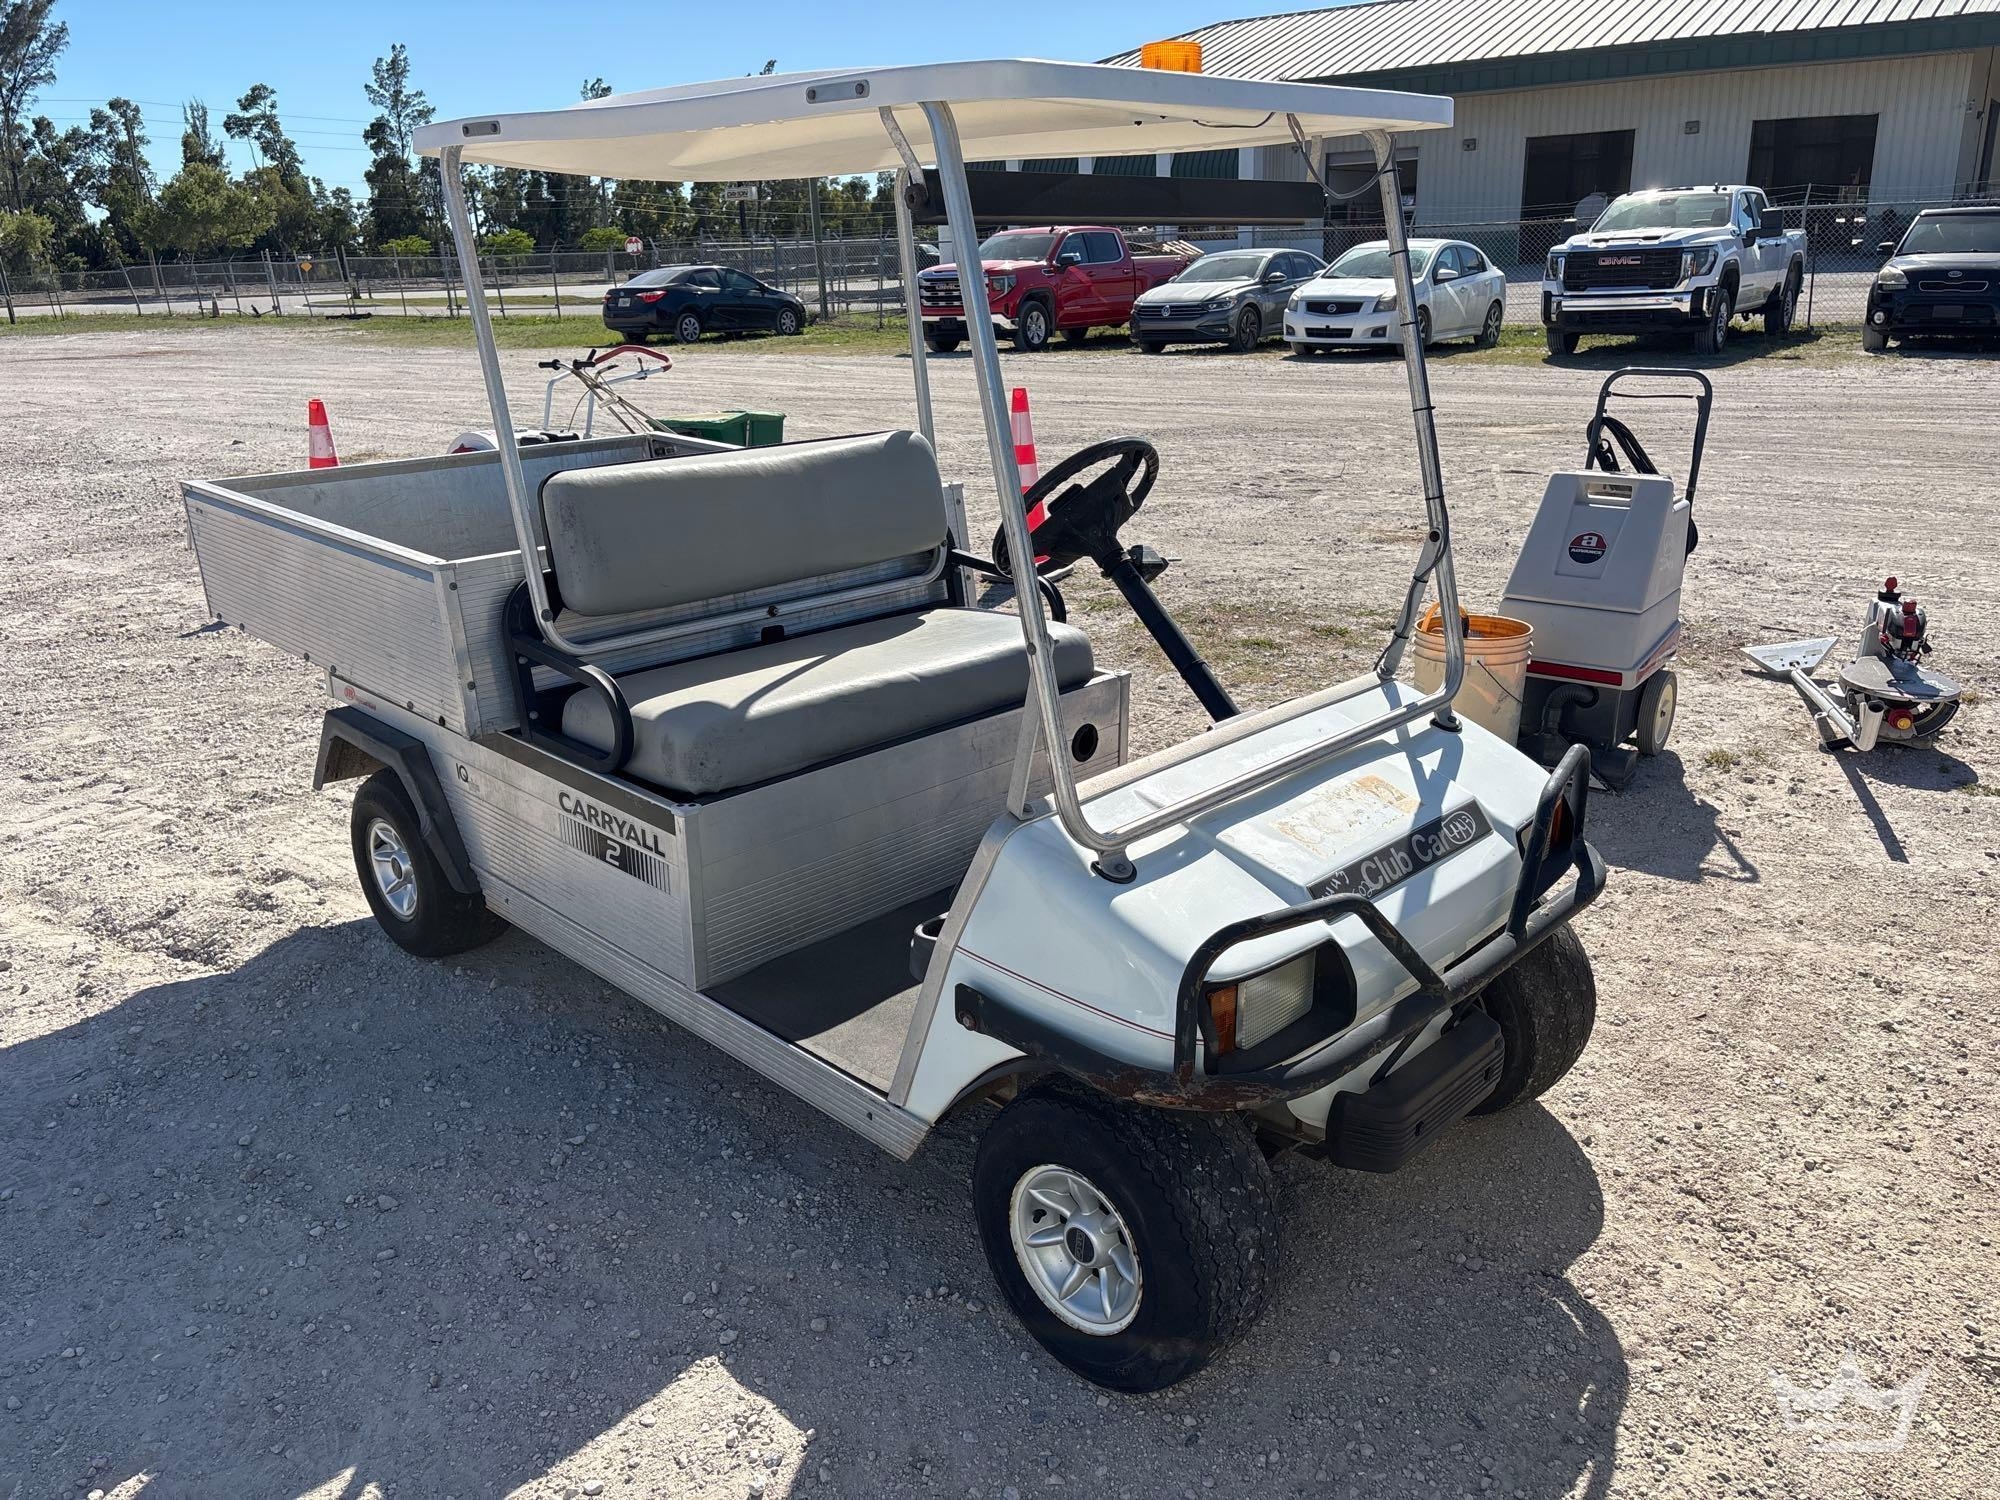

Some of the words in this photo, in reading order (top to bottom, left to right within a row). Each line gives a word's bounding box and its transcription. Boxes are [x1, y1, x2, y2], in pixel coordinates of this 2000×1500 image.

[1598, 256, 1641, 265] GMC
[455, 762, 469, 783] IQ
[558, 791, 666, 859] CARRYALL
[605, 839, 621, 866] 2
[1360, 847, 1413, 890] Club
[1411, 831, 1451, 863] Car
